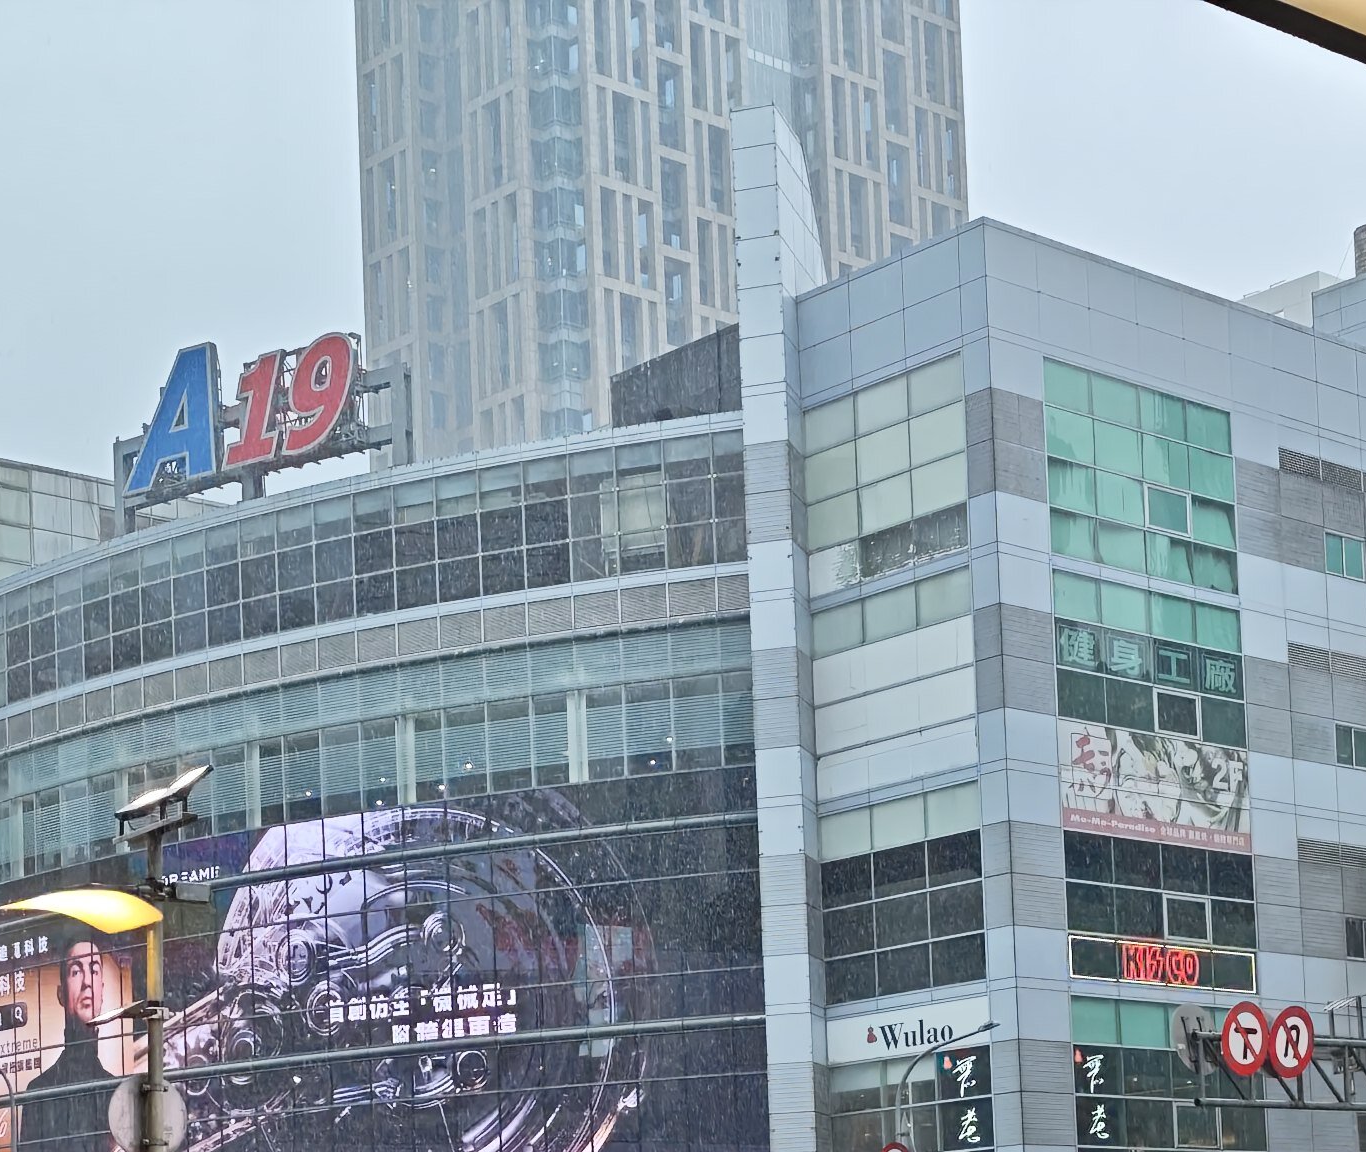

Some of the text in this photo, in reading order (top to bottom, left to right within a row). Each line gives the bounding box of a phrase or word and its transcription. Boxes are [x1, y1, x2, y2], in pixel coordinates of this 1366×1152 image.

[122, 331, 356, 499] A19
[1059, 628, 1237, 693] 健身工廠
[1211, 757, 1244, 793] 2F
[879, 1019, 954, 1051] Wulao
